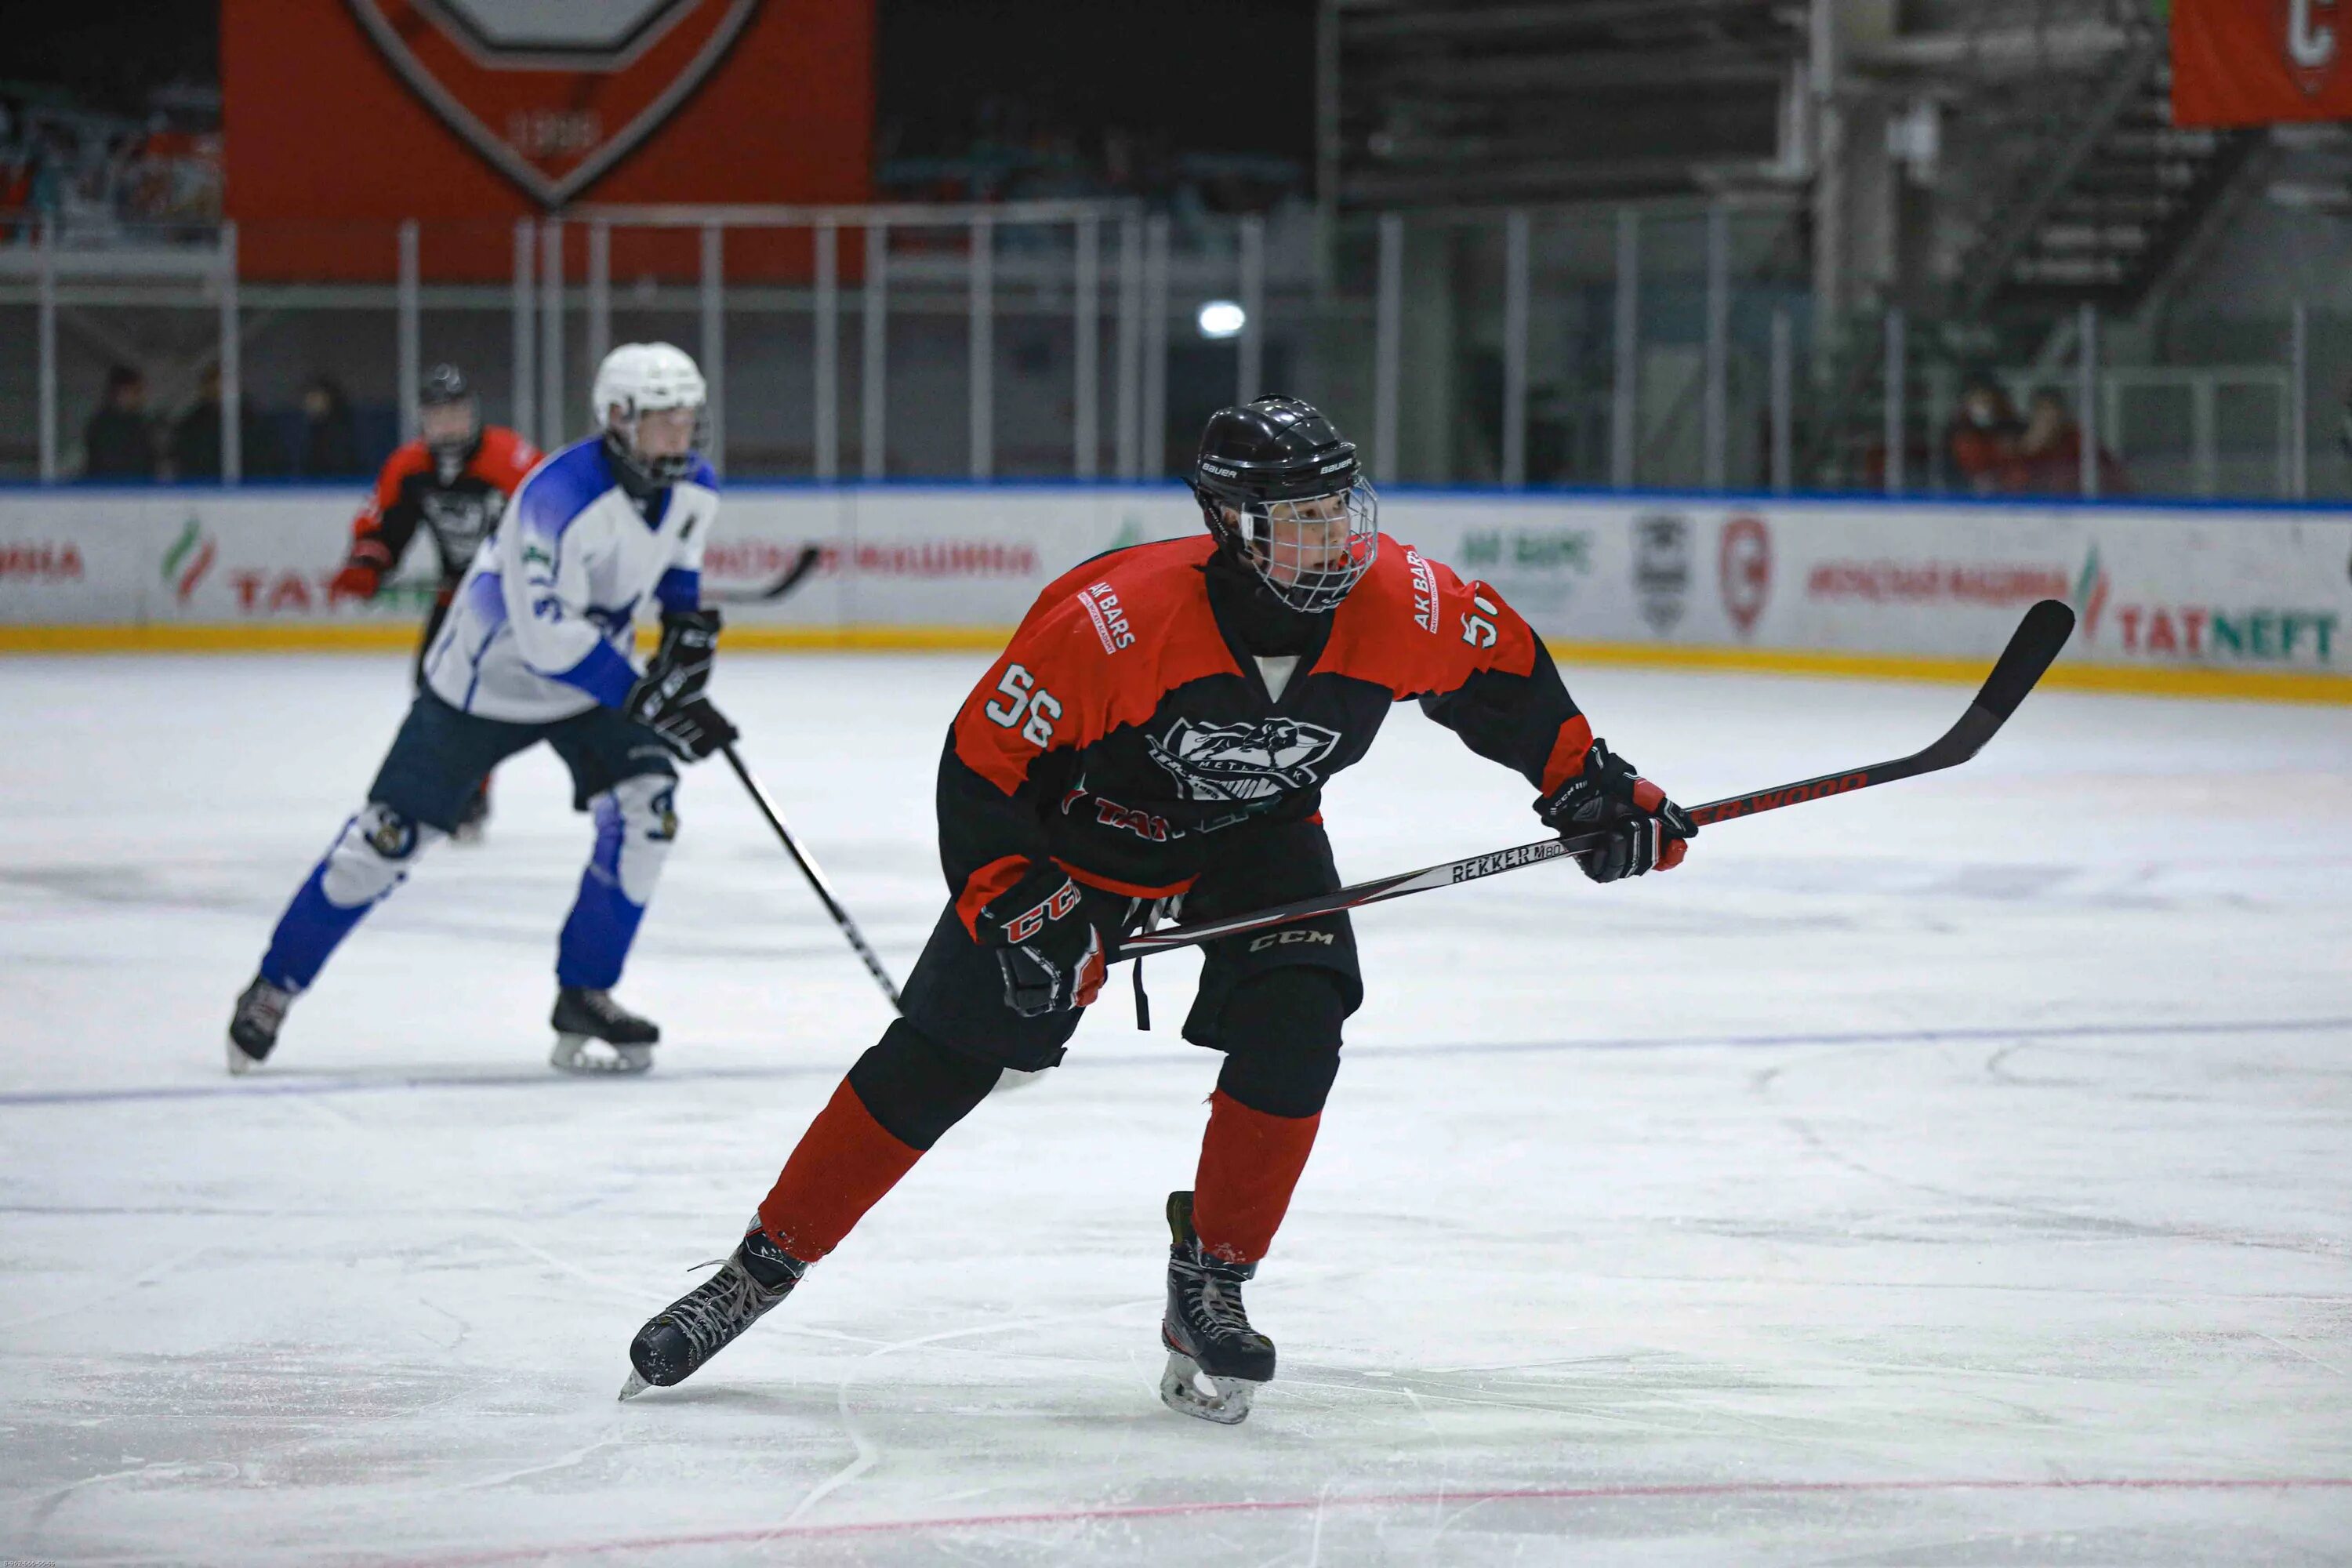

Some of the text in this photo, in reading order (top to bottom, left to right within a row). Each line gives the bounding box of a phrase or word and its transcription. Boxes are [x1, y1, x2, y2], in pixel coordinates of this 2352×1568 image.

[1202, 463, 1238, 479] BAUER
[1320, 459, 1353, 475] BAUER
[1087, 582, 1136, 649] AK BARS
[1414, 594, 1430, 630] AK
[2115, 605, 2339, 662] TATNEFT
[985, 661, 1064, 750] 56
[1453, 844, 1562, 884] REKKER M80
[1000, 877, 1082, 944] CC
[1249, 930, 1334, 953] CCM
